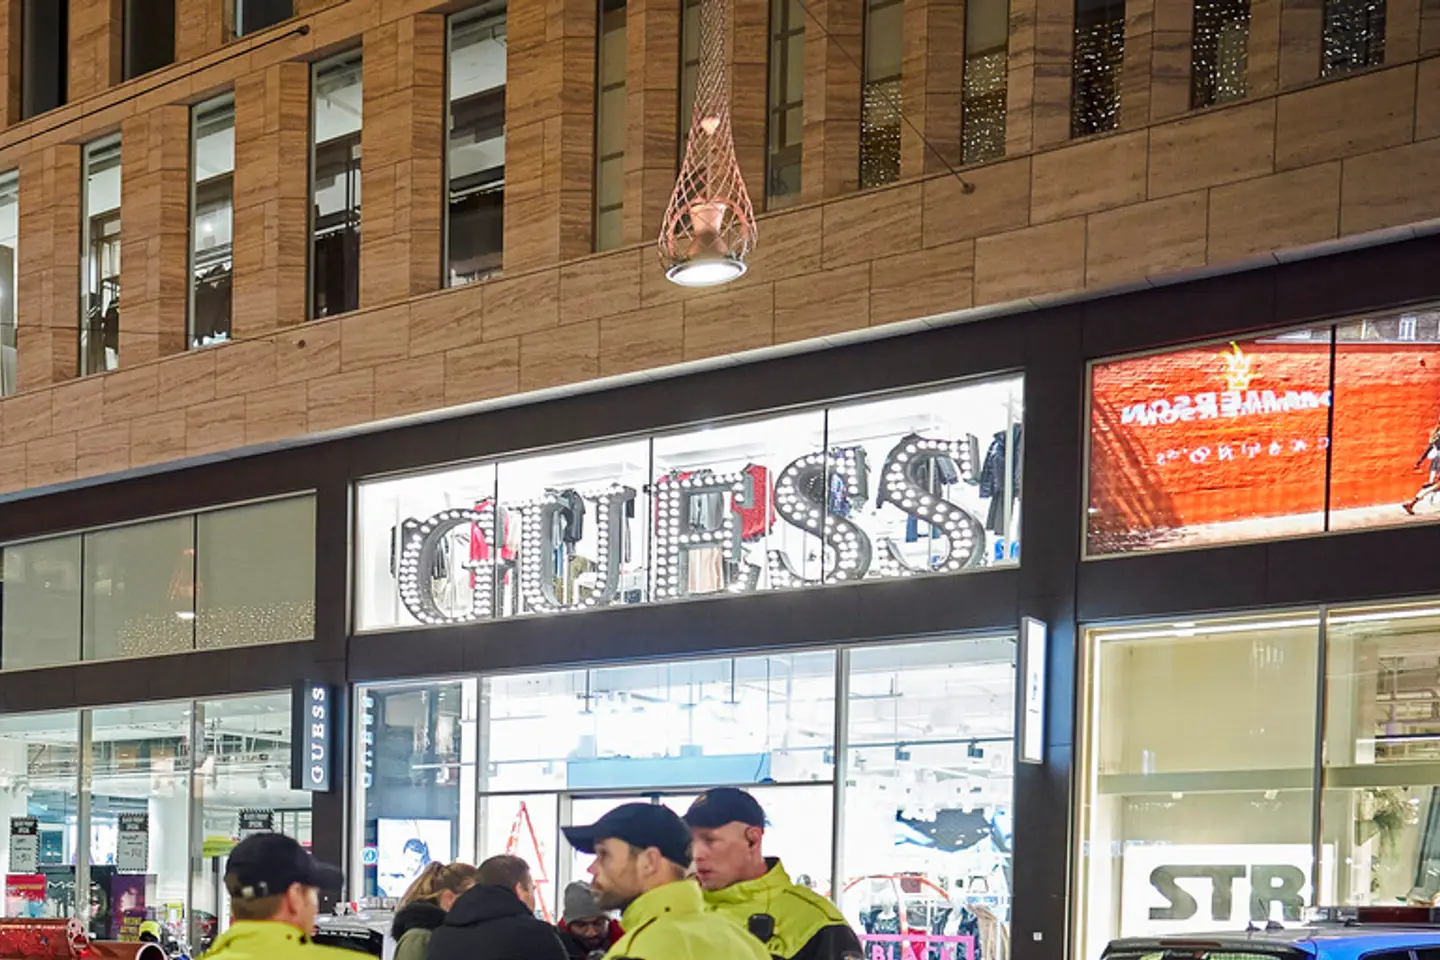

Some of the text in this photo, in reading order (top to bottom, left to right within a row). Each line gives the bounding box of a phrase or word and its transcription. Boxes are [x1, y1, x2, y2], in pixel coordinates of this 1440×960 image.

[396, 432, 986, 626] GUESS
[311, 687, 326, 784] GUESS
[1149, 864, 1306, 921] STR
